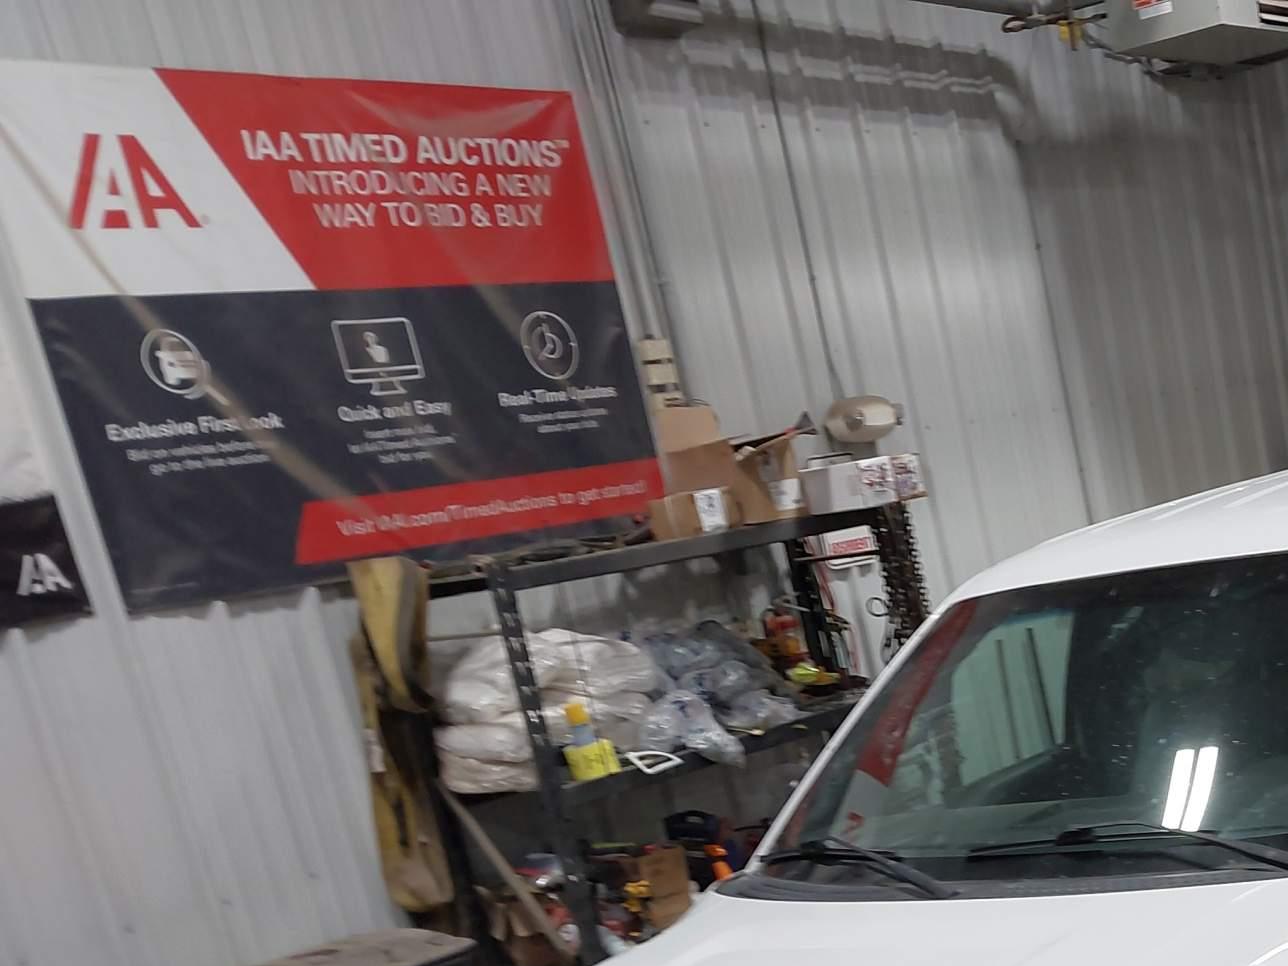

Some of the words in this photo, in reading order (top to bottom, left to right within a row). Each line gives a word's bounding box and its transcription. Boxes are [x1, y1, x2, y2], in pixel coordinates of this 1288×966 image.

[240, 129, 303, 162] IAA
[300, 132, 407, 164] TIMED
[68, 132, 203, 229] IAA
[288, 168, 472, 197] INTRODUCING
[475, 172, 495, 197] A
[496, 173, 552, 197] NEW
[313, 202, 376, 228] WAY
[381, 201, 421, 228] TO
[425, 202, 467, 228] BID
[471, 203, 492, 227] &
[494, 203, 544, 228] BUY
[337, 403, 382, 422] Quick
[382, 400, 414, 418] and
[413, 399, 453, 417] Easy
[104, 418, 199, 442] Exclusive
